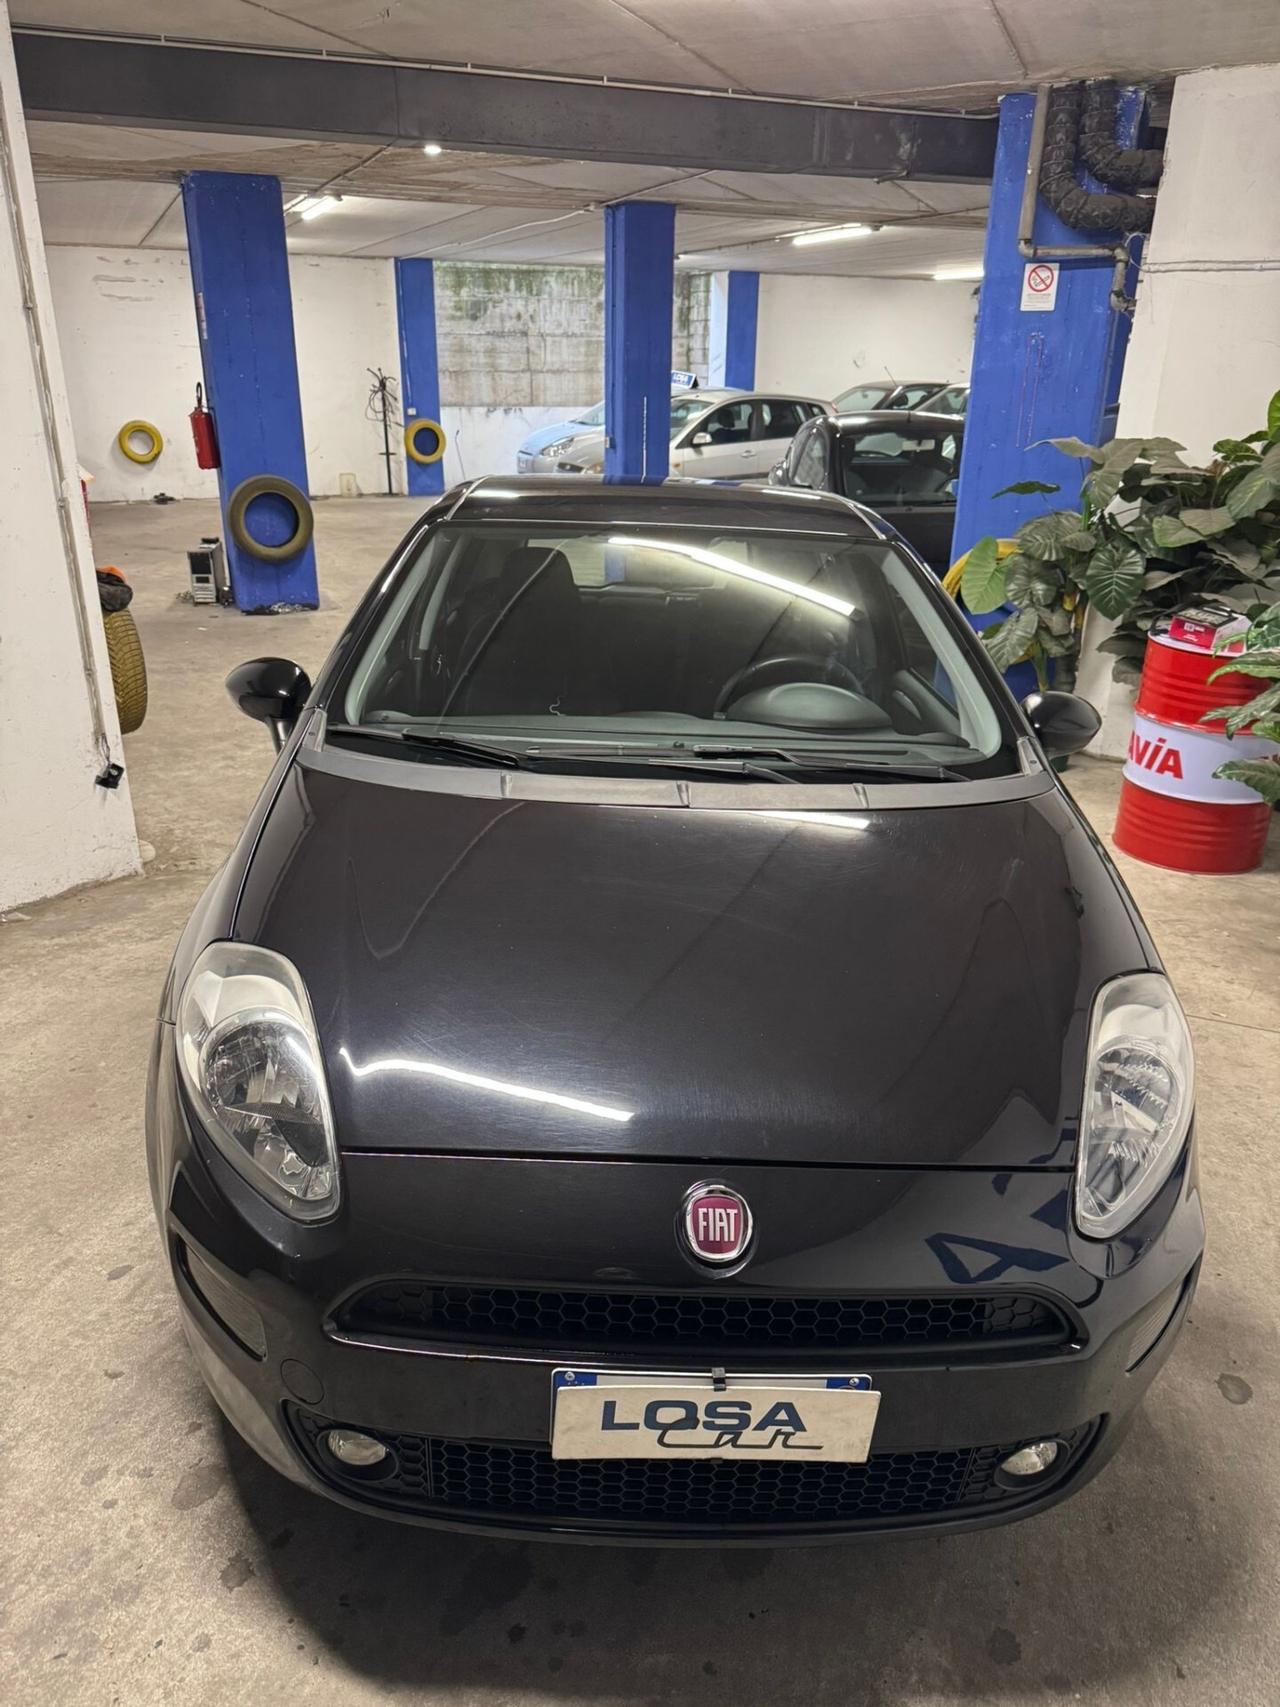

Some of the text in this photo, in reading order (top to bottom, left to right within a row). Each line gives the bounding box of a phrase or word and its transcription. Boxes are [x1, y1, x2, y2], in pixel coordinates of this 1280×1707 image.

[697, 1207, 738, 1242] FIAT
[601, 1400, 807, 1432] LOSA
[657, 1417, 823, 1450] Car
